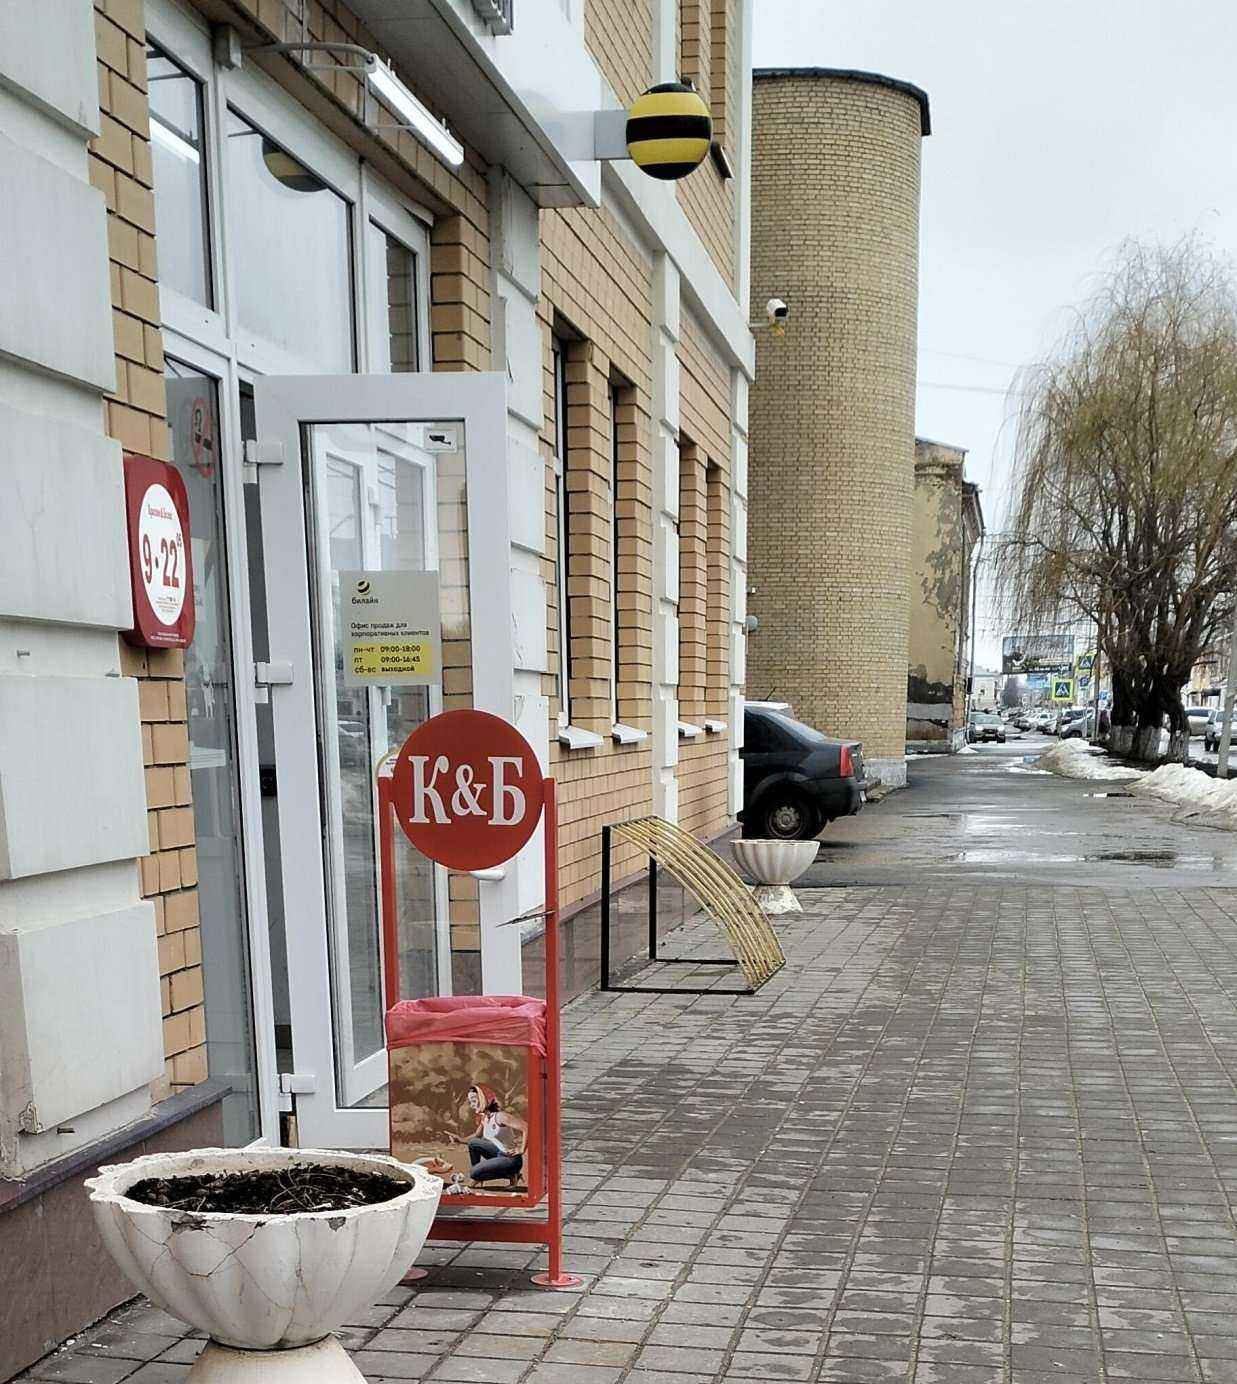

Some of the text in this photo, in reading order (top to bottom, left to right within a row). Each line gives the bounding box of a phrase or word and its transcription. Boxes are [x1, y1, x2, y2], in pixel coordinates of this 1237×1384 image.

[351, 597, 379, 605] билайн
[351, 622, 369, 630] Офис
[408, 755, 526, 826] К&Б
